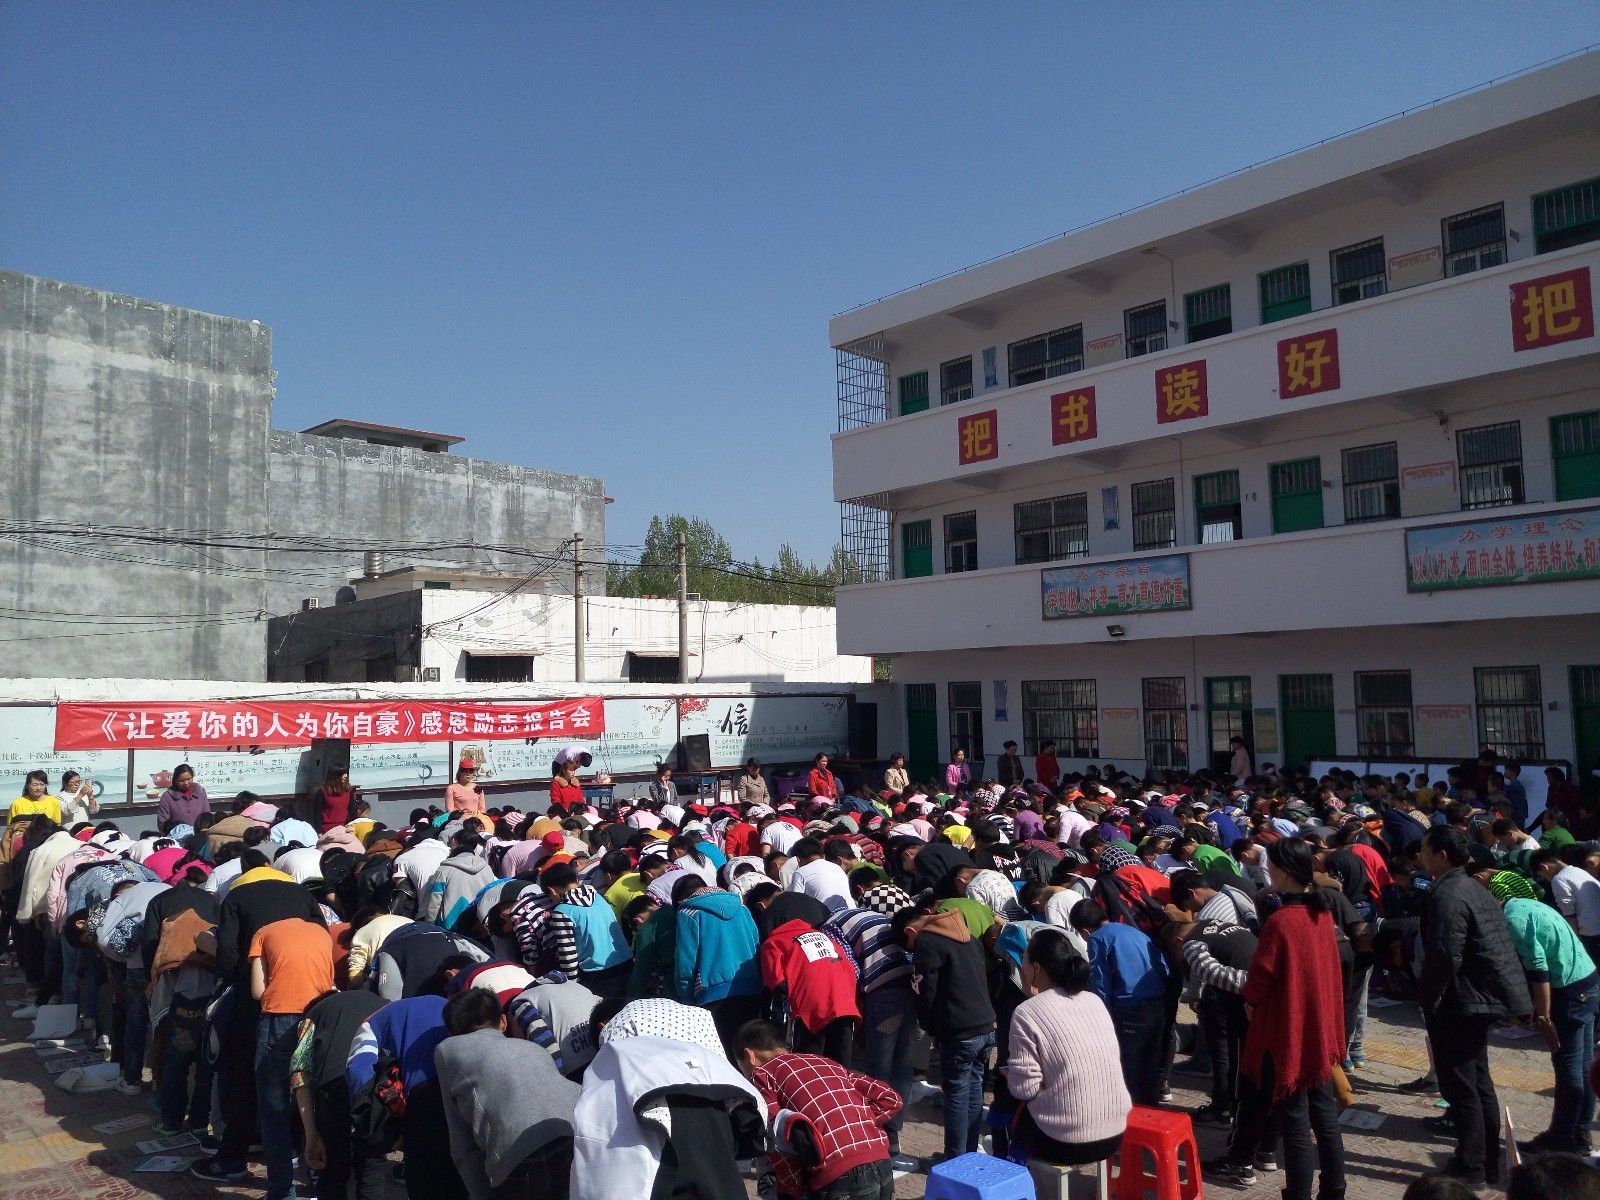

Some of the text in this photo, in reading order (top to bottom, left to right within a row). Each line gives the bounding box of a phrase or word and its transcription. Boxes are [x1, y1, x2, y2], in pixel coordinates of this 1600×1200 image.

[1522, 286, 1580, 342] 把
[1458, 518, 1584, 544] 办学理念
[1412, 549, 1461, 583] 以人为本
[1466, 545, 1517, 578] 面向全体
[1523, 539, 1577, 574] 培养特长
[721, 702, 749, 737] 信
